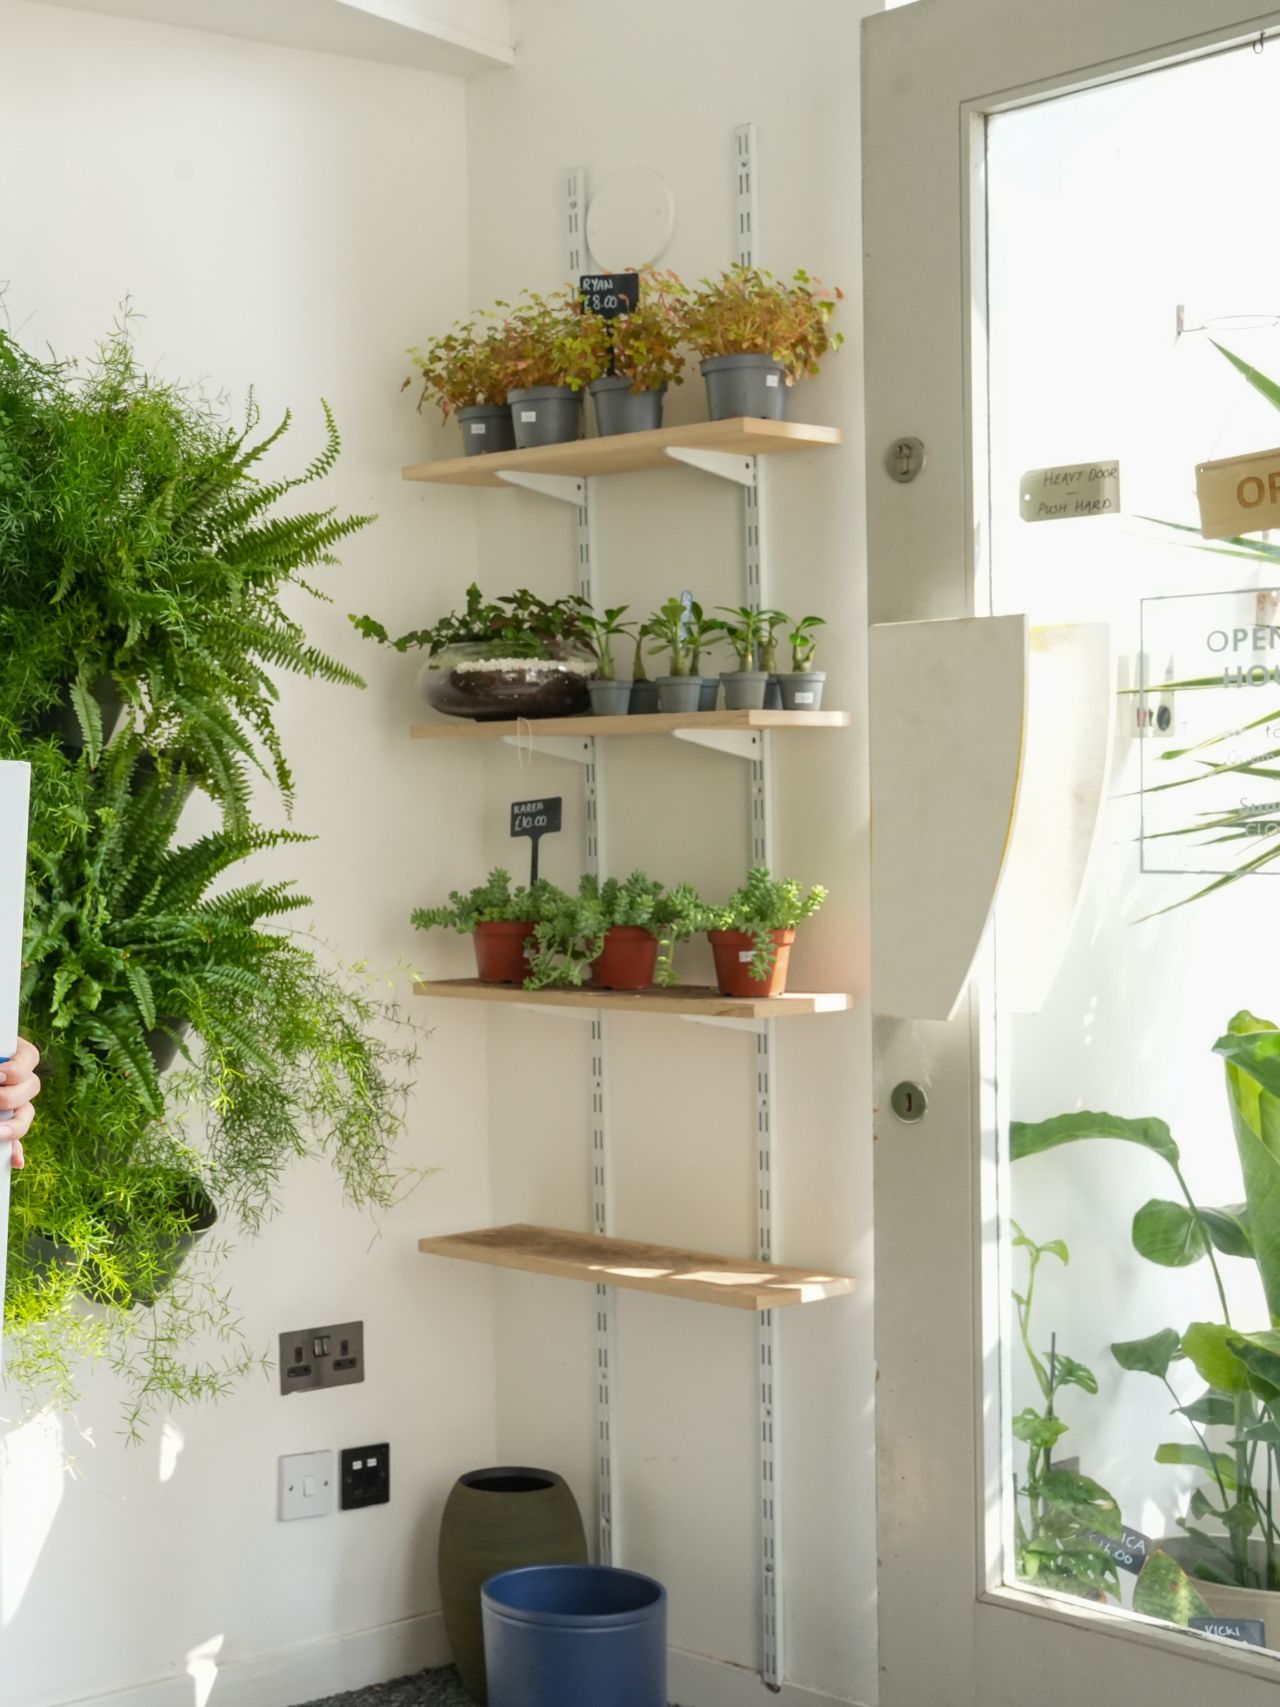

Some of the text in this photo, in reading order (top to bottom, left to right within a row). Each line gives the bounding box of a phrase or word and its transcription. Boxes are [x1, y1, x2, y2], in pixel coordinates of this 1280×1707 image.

[582, 278, 614, 292] RYAN
[1043, 463, 1119, 487] HEAVY DOOR
[1036, 498, 1112, 516] PUSH HARD
[514, 815, 547, 831] £10.00
[1121, 1532, 1146, 1556] ICA
